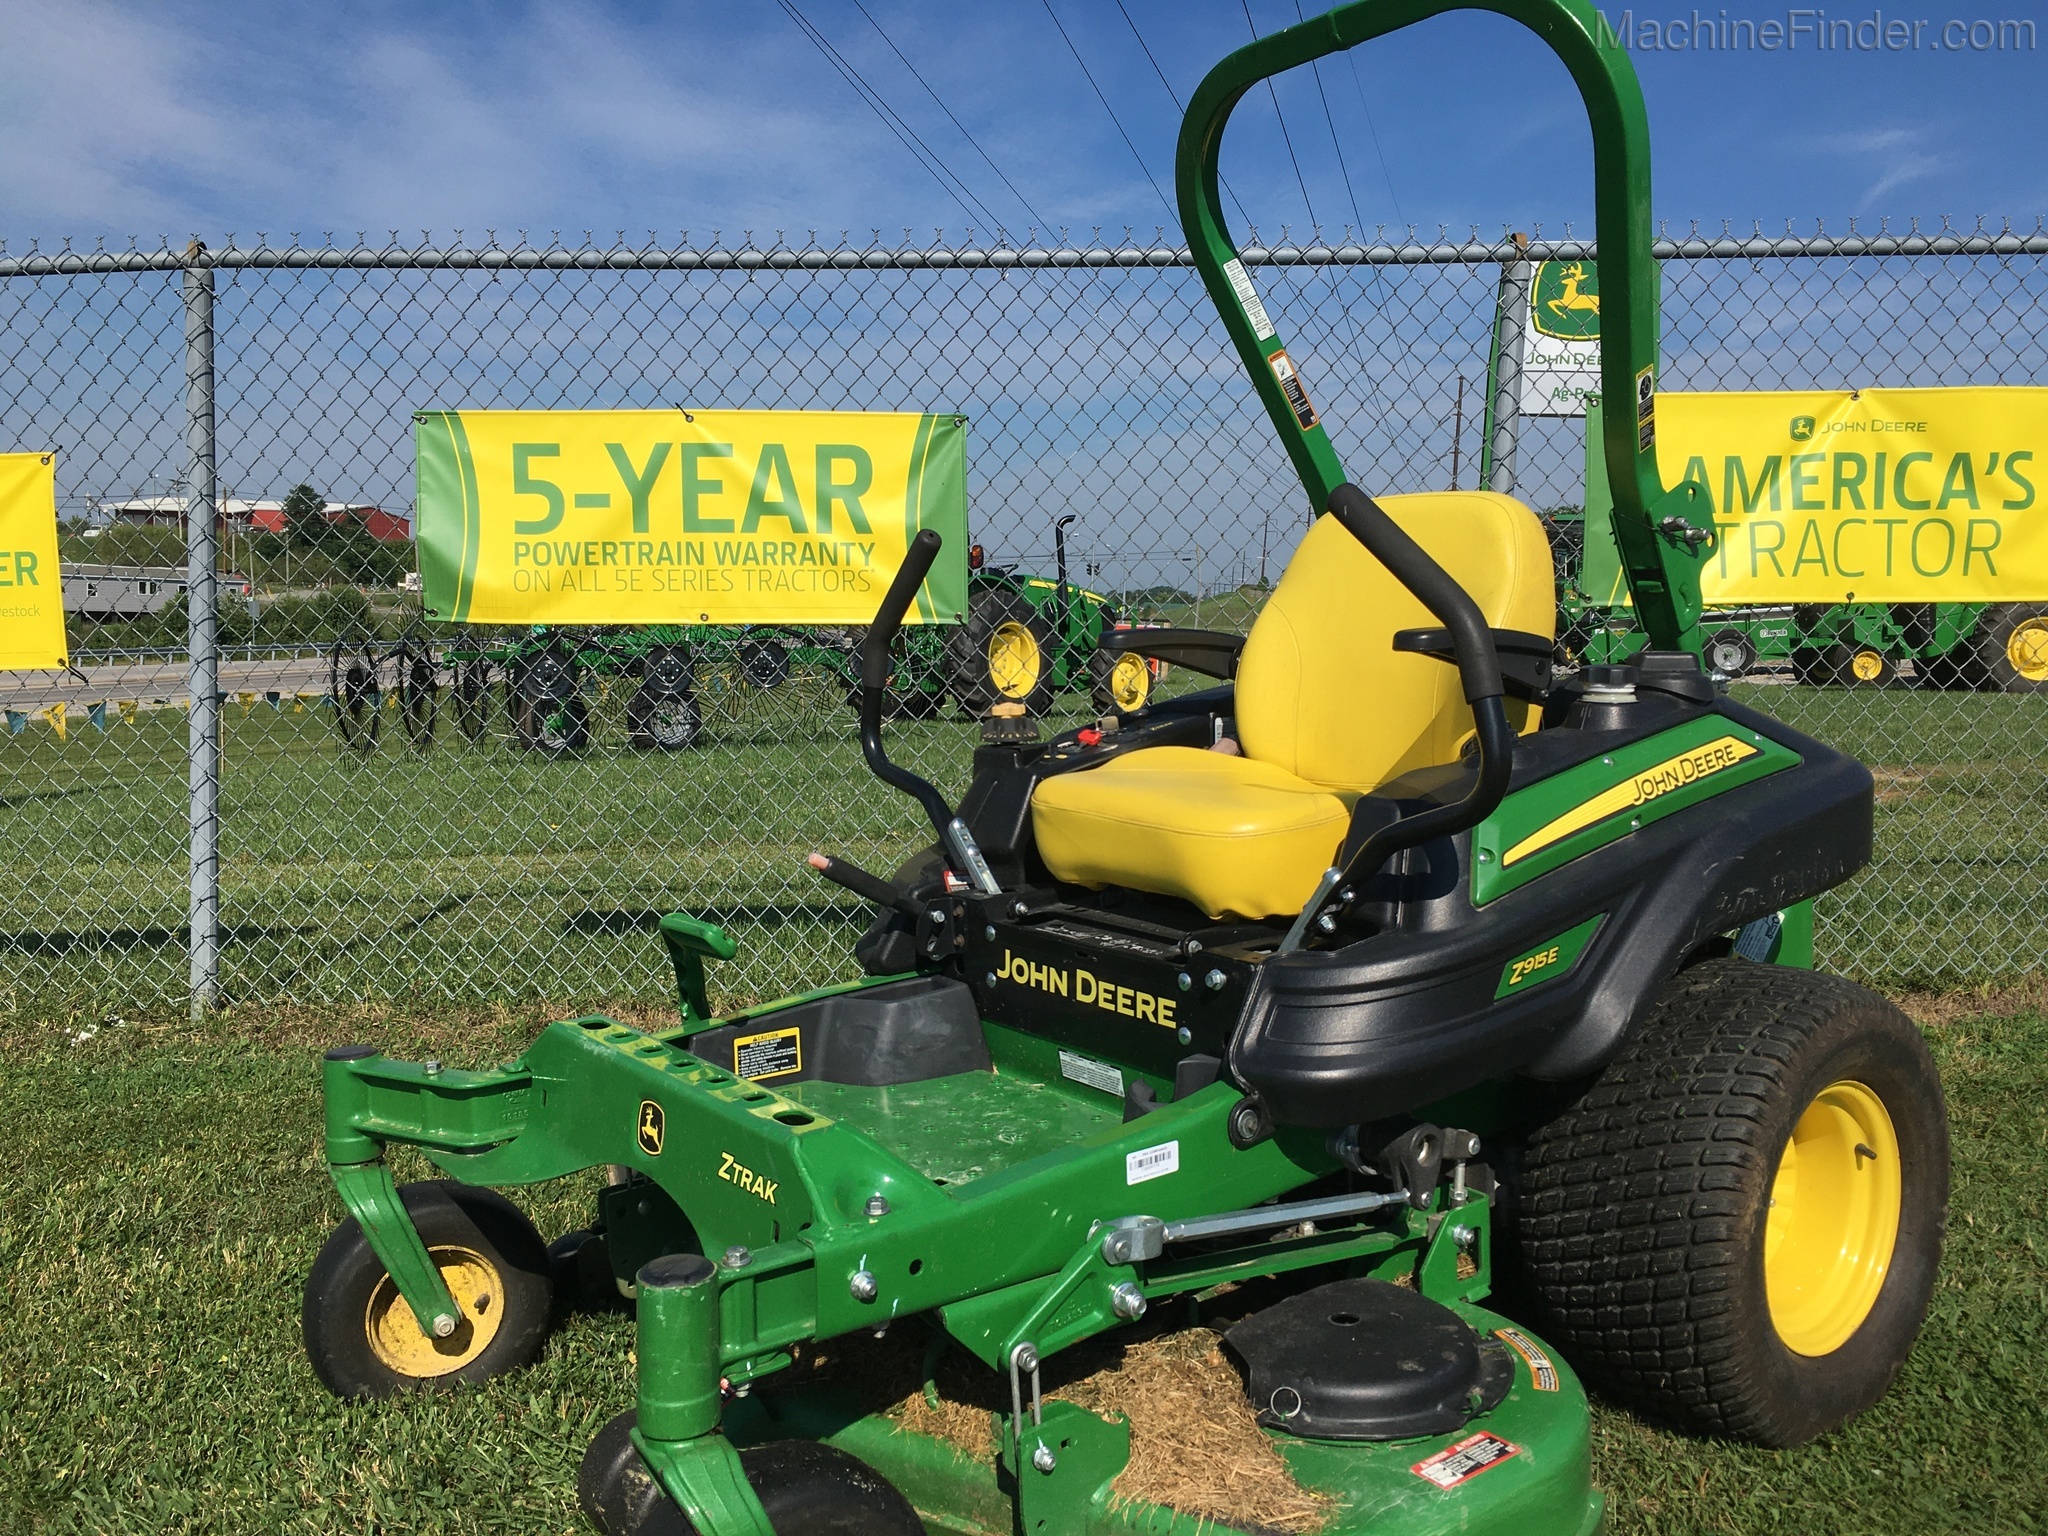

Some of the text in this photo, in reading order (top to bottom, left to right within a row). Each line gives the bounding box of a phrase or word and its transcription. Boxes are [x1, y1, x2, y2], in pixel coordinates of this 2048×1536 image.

[1525, 352, 1570, 365] JOHN
[1821, 419, 1929, 435] JOHN DEERE
[512, 442, 874, 535] 5-YEAR
[513, 541, 876, 567] POWERTRAIN WARRANTY
[1715, 517, 2003, 580] TRACTOR
[513, 569, 551, 593] ON
[560, 569, 607, 592] ALL
[615, 569, 644, 592] 5E
[652, 569, 734, 593] SERIES
[0, 603, 42, 618] estock
[1633, 744, 1738, 803] JOHN DEERE
[1508, 946, 1560, 985] Z915E
[997, 949, 1177, 1029] JOHN DEERE
[717, 1152, 779, 1205] ZTRAK
